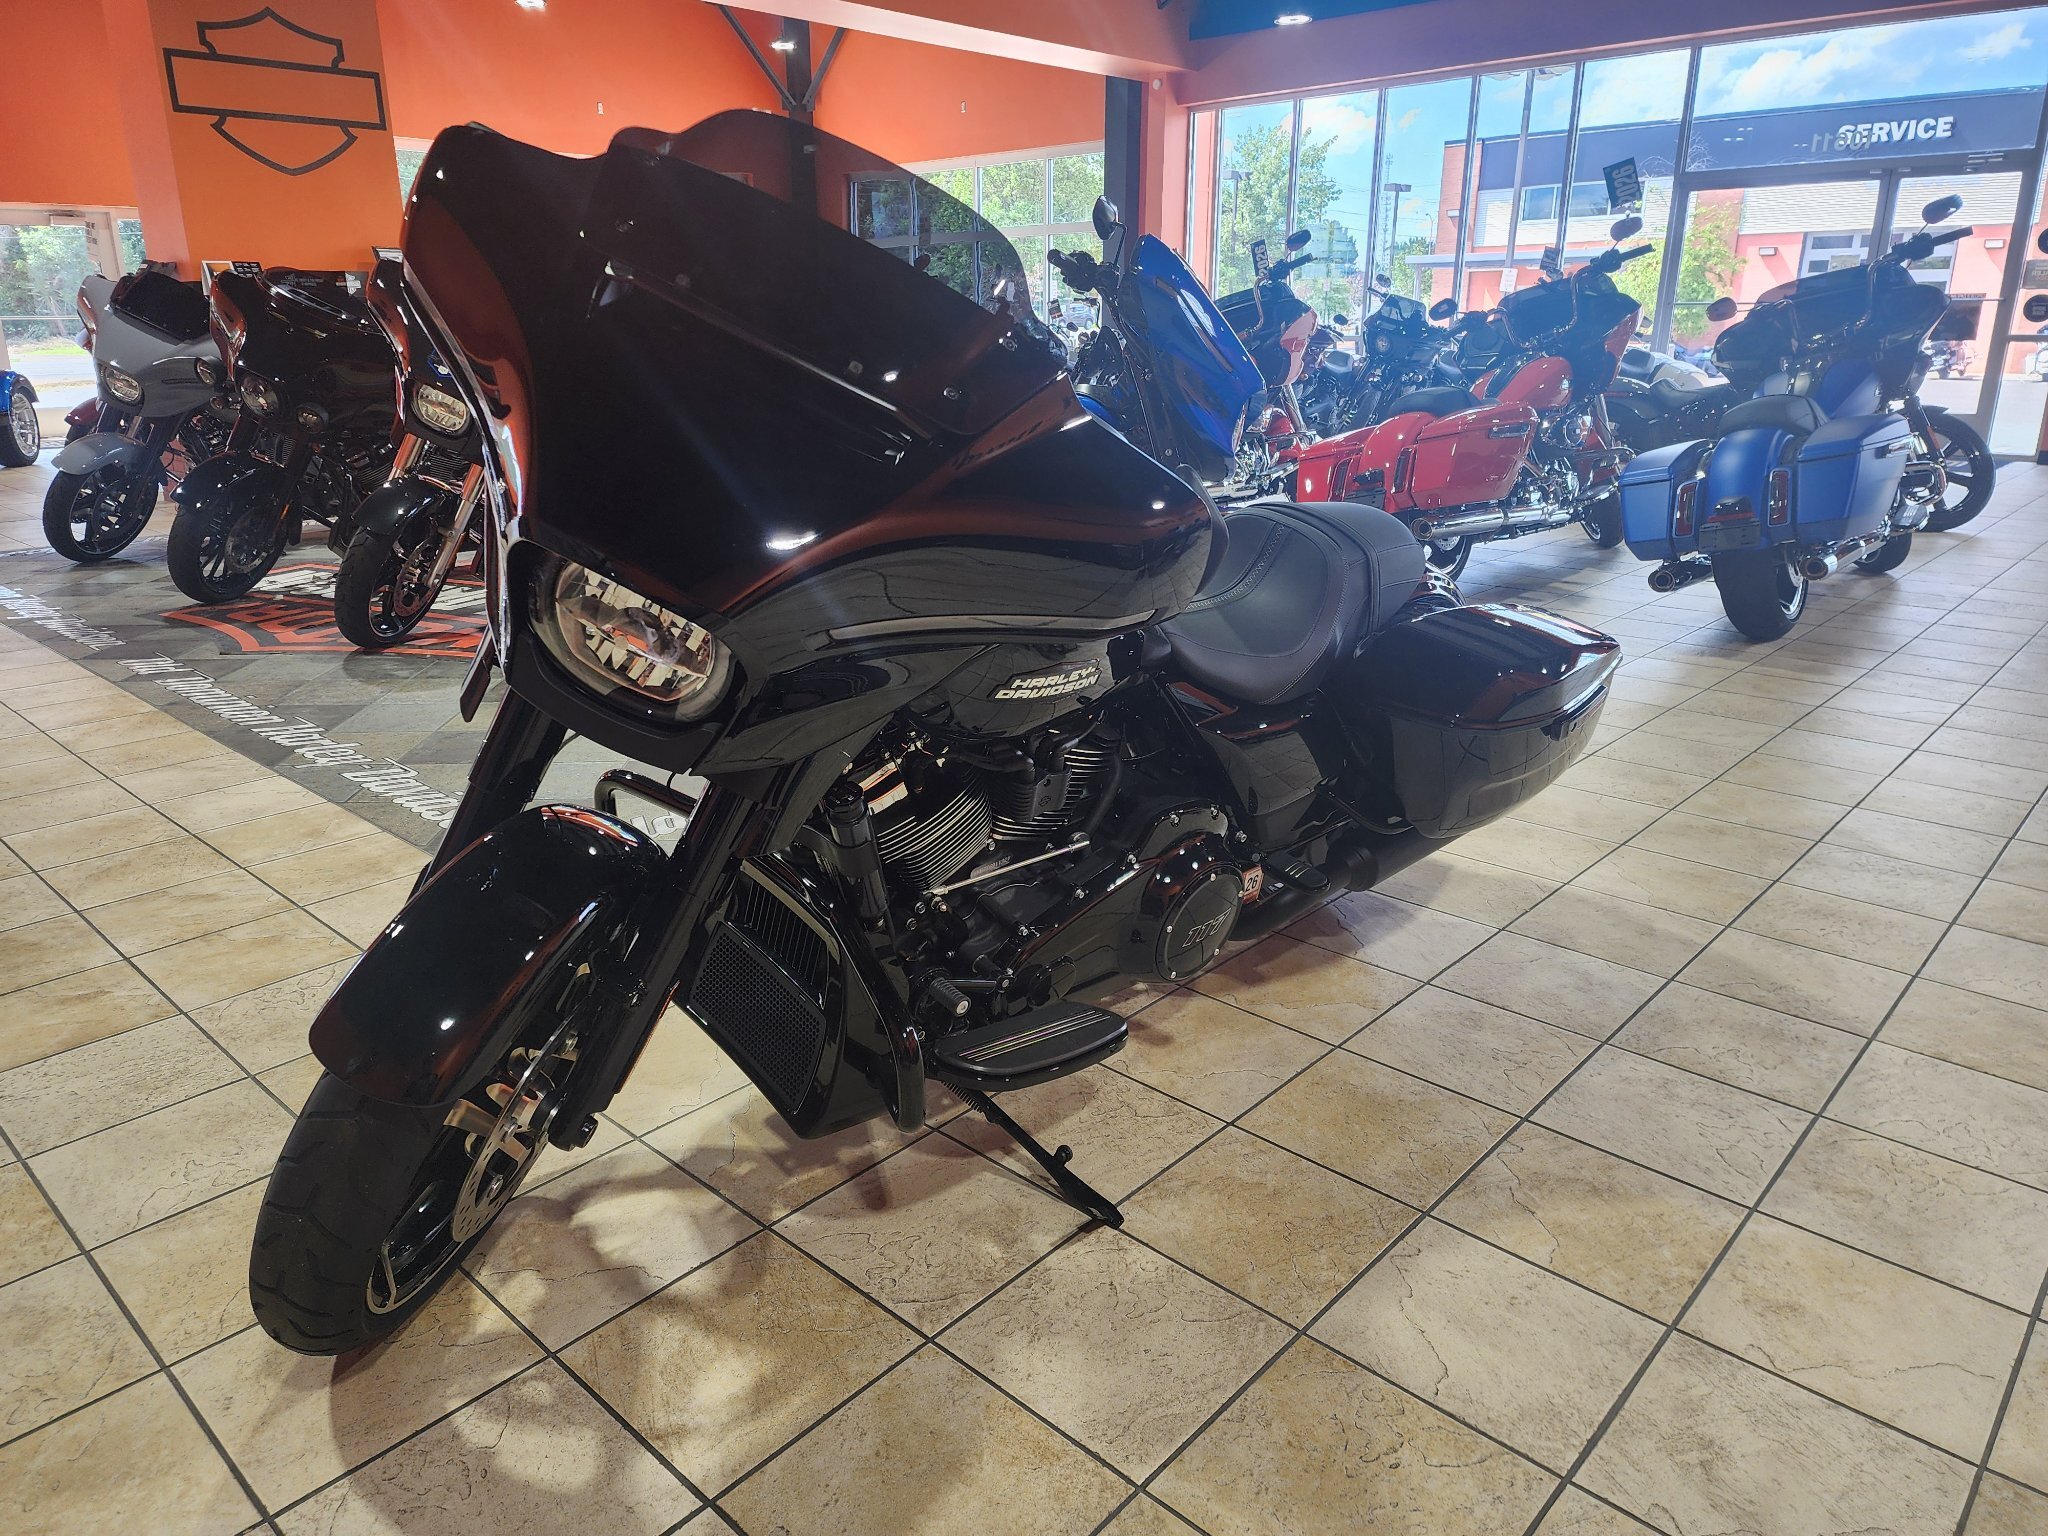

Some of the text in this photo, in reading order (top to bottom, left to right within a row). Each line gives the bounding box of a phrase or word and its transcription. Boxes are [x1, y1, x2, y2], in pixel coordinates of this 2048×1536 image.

[1838, 116, 1954, 146] SERVICE
[150, 669, 287, 727] Dominion
[995, 675, 1099, 699] DAVIDSON
[1245, 875, 1258, 892] 26
